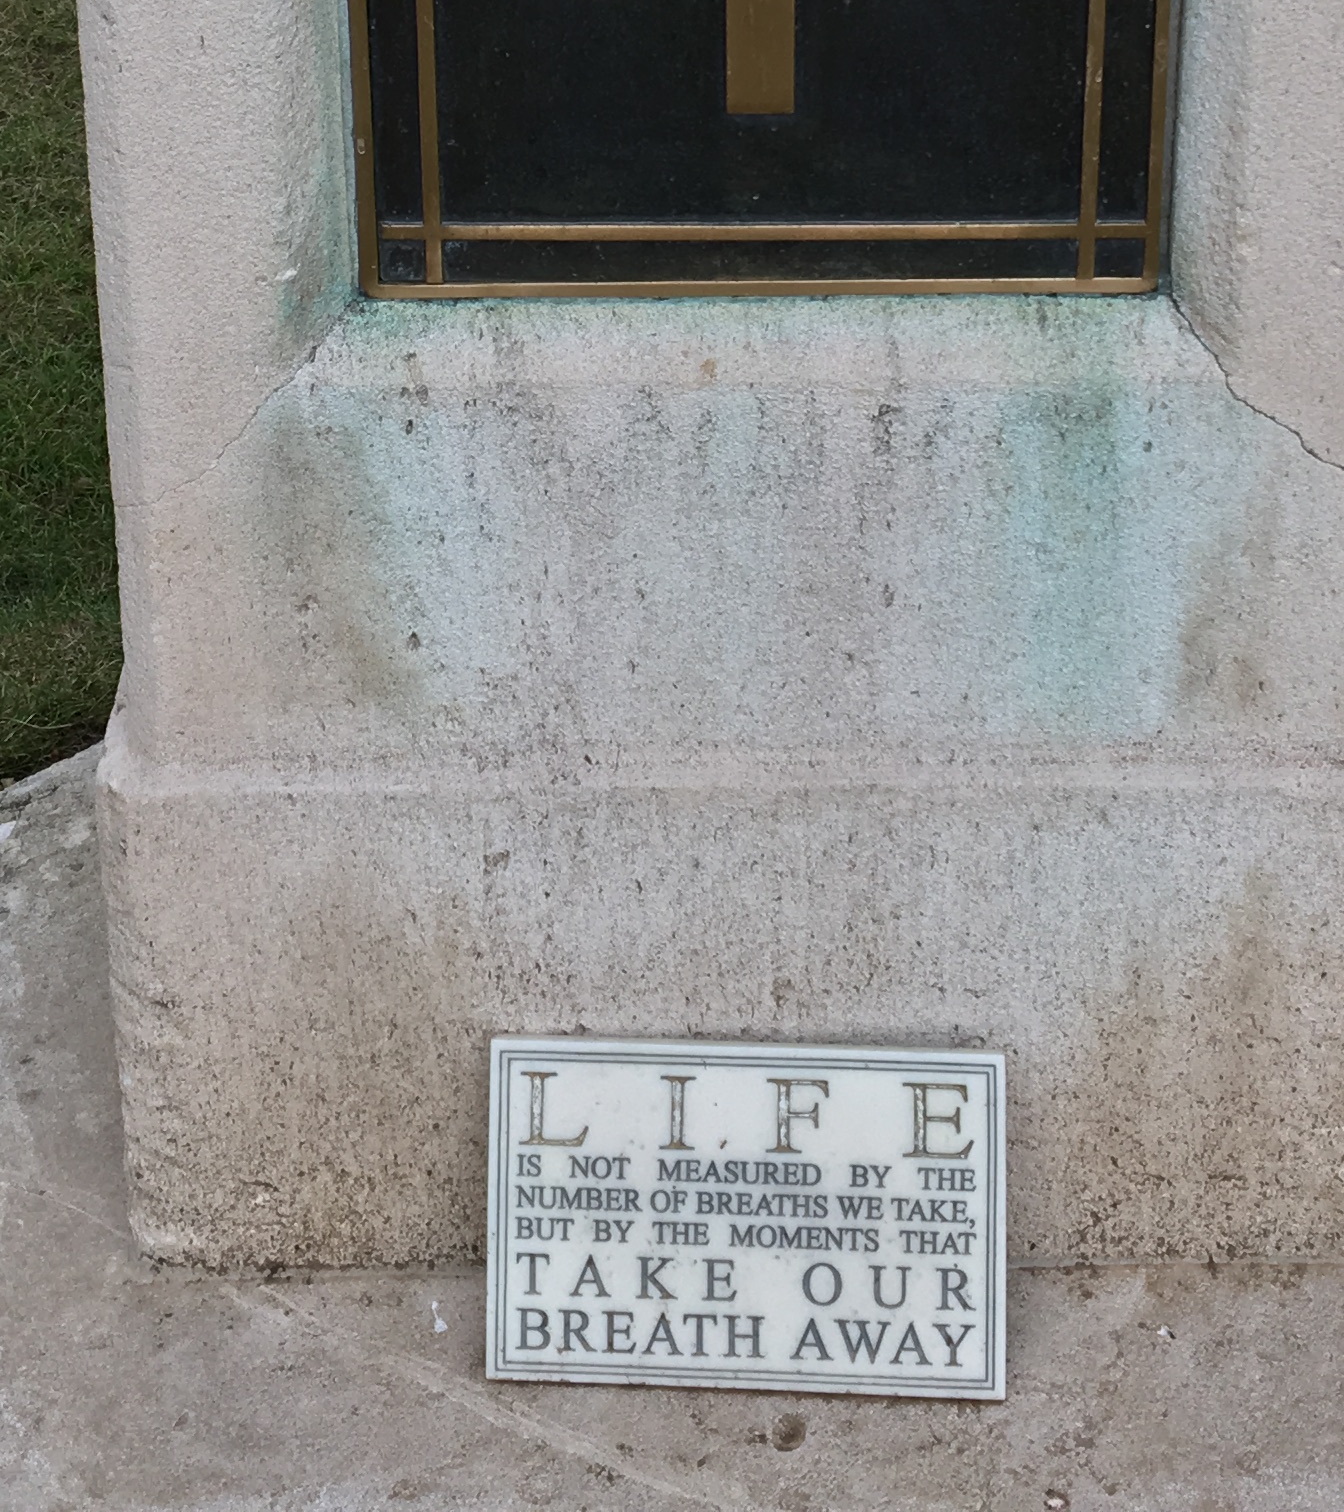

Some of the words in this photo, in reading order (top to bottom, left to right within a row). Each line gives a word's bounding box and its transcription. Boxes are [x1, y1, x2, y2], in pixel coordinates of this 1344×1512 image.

[518, 1072, 975, 1159] LIFE
[516, 1154, 542, 1178] IS
[569, 1156, 631, 1181] NOT
[657, 1159, 822, 1186] MEASURED
[849, 1165, 892, 1188] BY
[917, 1167, 976, 1192] THE
[516, 1186, 643, 1212] NUMBER
[650, 1190, 688, 1214] OF
[696, 1193, 828, 1219] BREATHS
[838, 1196, 884, 1221] WE
[890, 1199, 976, 1228] TAKE,
[515, 1218, 575, 1242] BUT
[594, 1220, 632, 1244] BY
[652, 1221, 709, 1246] THE
[729, 1224, 880, 1252] MOMENTS
[899, 1231, 977, 1255] THAT
[516, 1253, 738, 1301] TAKE
[802, 1262, 976, 1311] OUR
[515, 1308, 765, 1359] BREATH
[790, 1318, 976, 1367] AWAY
